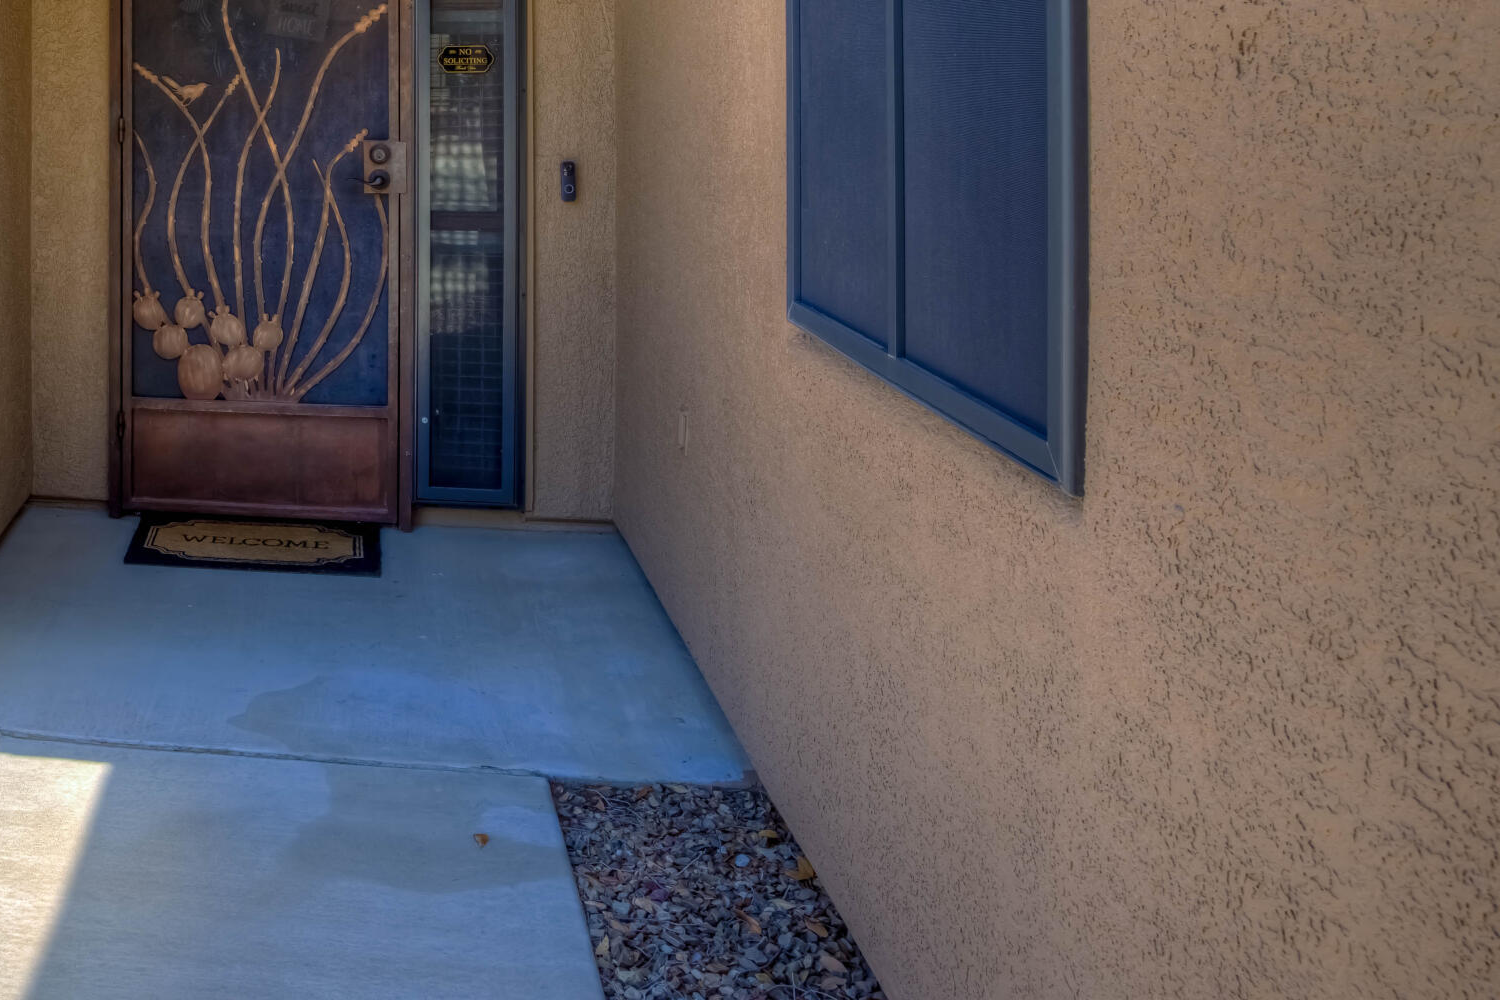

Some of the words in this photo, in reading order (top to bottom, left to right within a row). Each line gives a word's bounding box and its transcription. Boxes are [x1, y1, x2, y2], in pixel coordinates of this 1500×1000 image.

[458, 48, 472, 56] NO
[443, 57, 488, 65] SOLICITING
[182, 533, 329, 550] WELCOME
